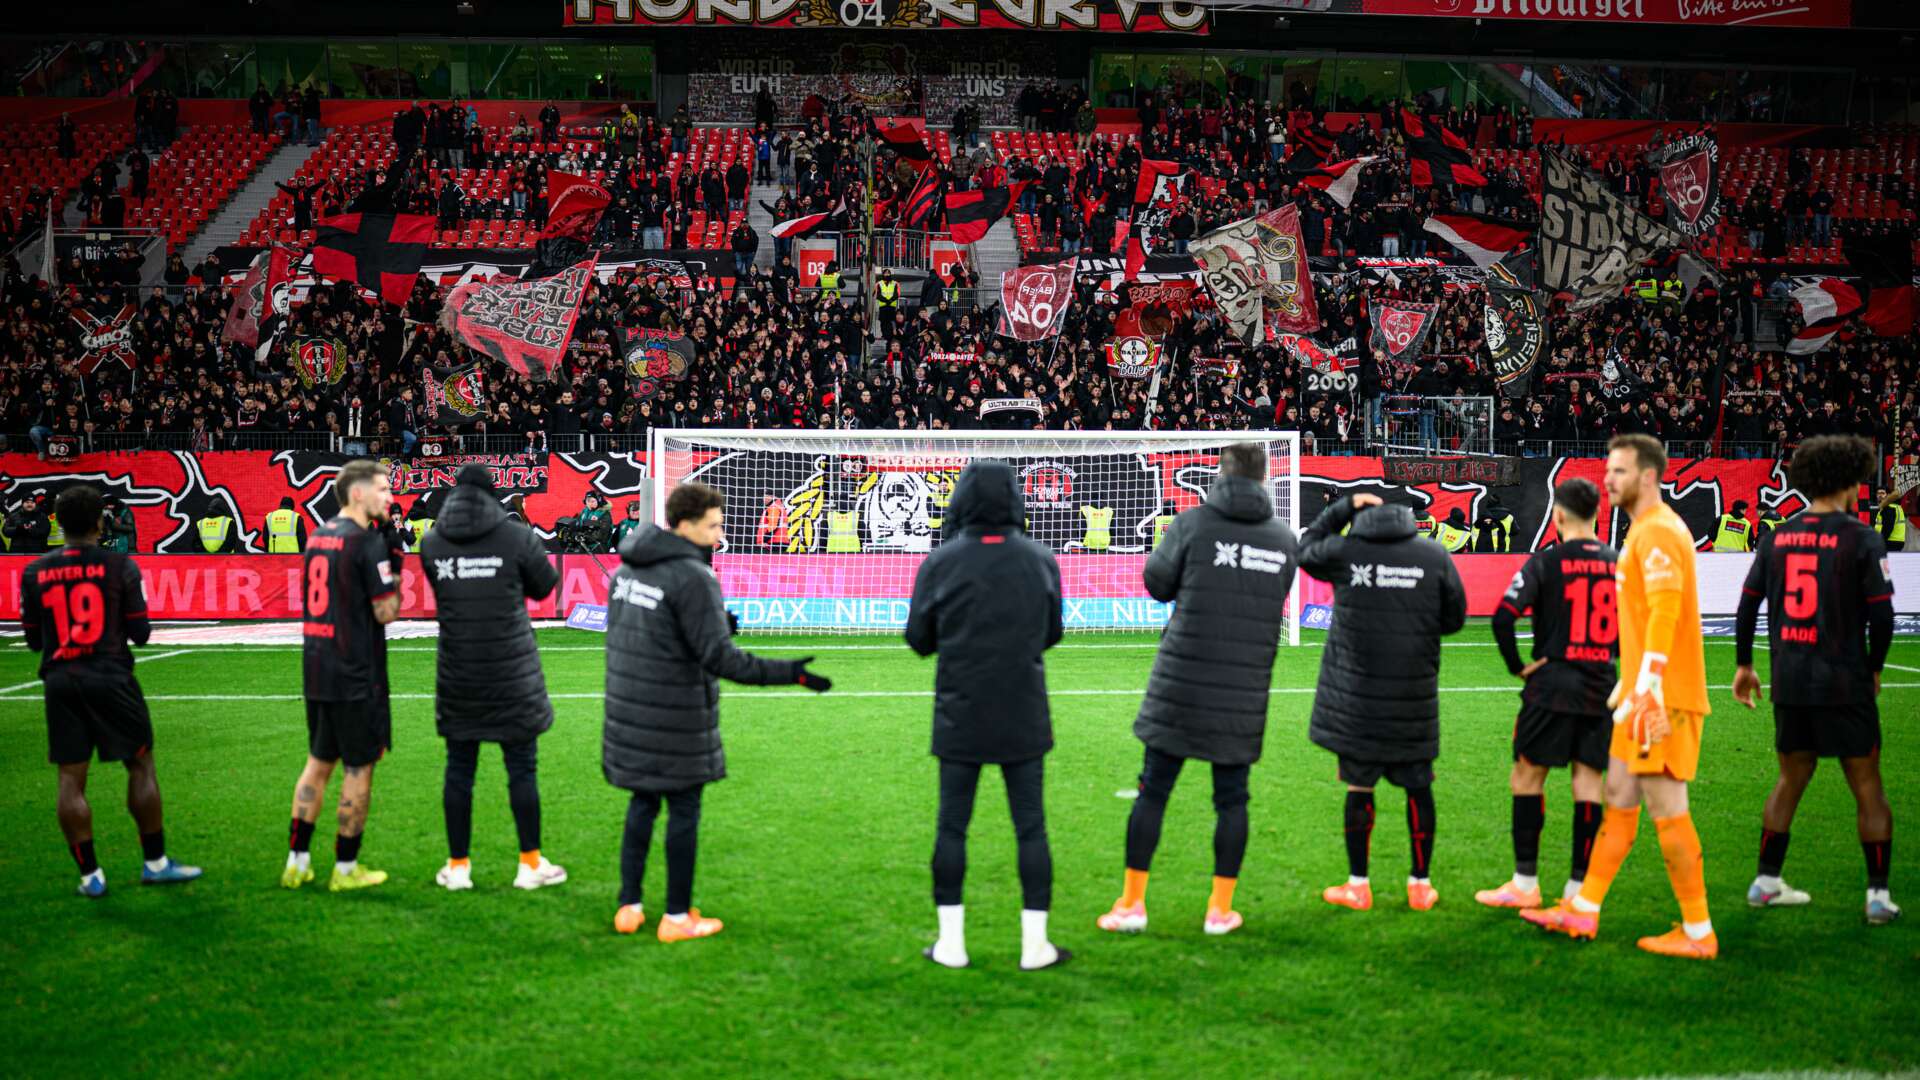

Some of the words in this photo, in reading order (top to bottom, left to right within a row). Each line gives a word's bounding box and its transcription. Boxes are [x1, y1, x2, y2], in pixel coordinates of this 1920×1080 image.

[967, 79, 1005, 96] UNS
[807, 262, 825, 276] D3
[1774, 533, 1817, 547] BAYER
[1819, 534, 1838, 548] 04
[37, 567, 82, 583] BAYER
[1562, 560, 1606, 575] BAYER
[145, 568, 262, 612] WIR
[307, 555, 329, 616] 8
[1784, 553, 1818, 619] 5
[41, 582, 105, 646] 19
[1564, 576, 1617, 644] 18
